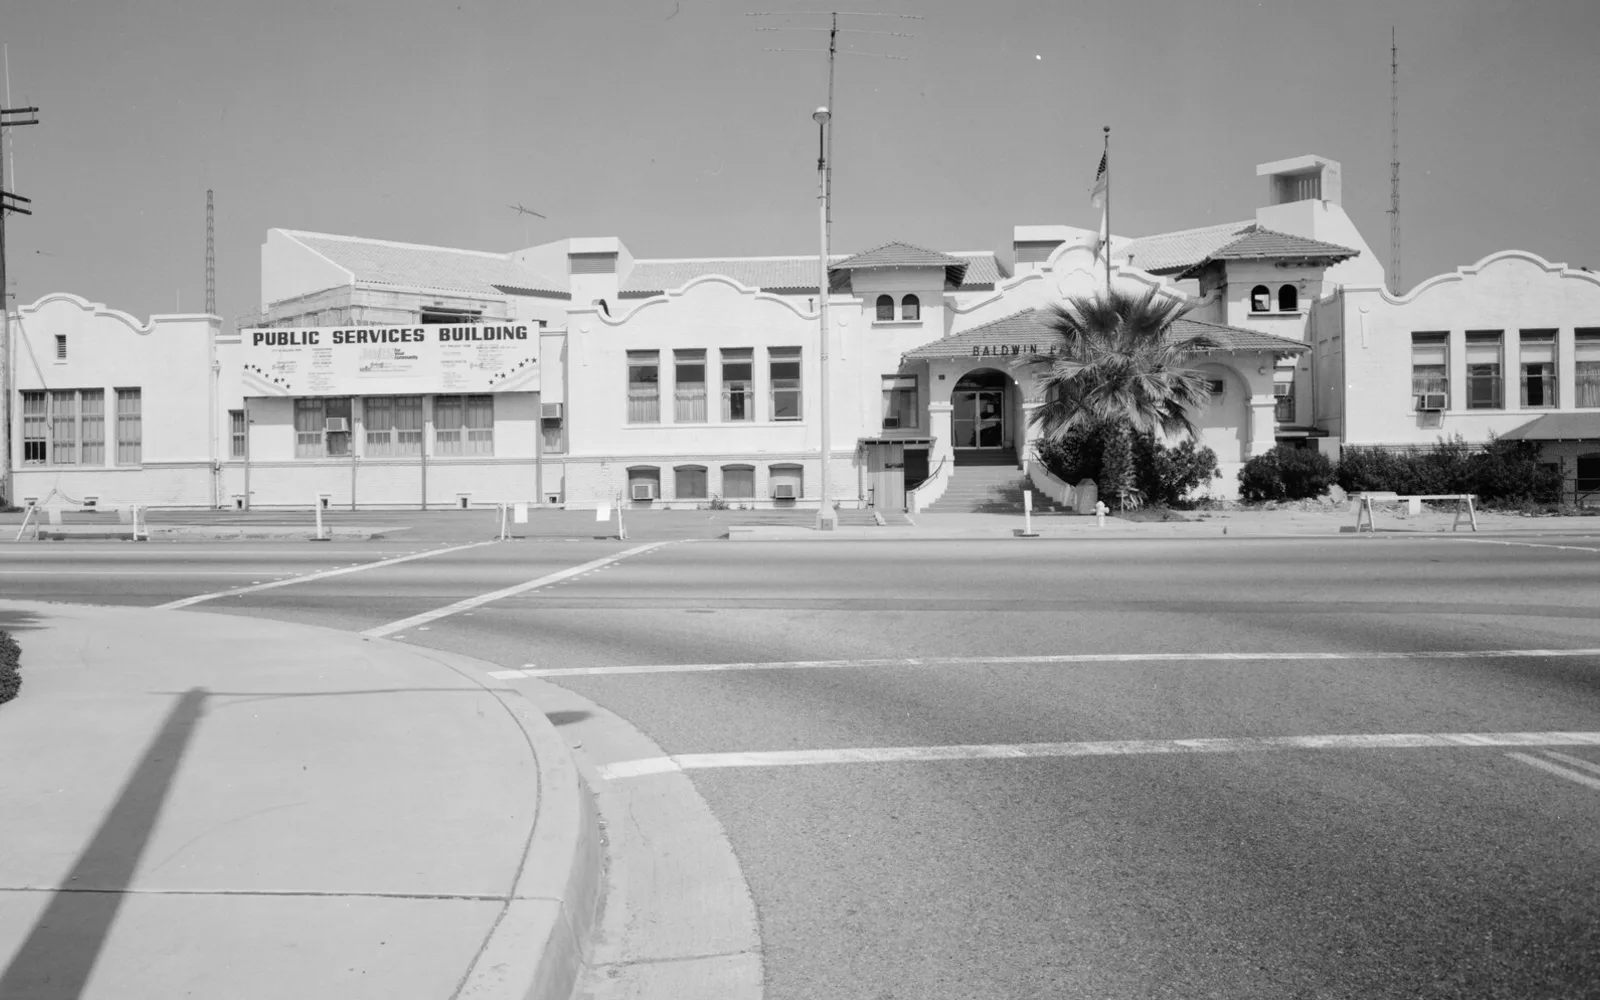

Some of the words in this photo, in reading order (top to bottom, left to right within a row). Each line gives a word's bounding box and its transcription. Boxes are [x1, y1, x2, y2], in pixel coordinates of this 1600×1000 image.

[253, 331, 320, 346] PUBLIC
[332, 329, 425, 344] SERVICES
[438, 326, 528, 342] BUILDING
[972, 344, 1037, 356] BALDWIN
